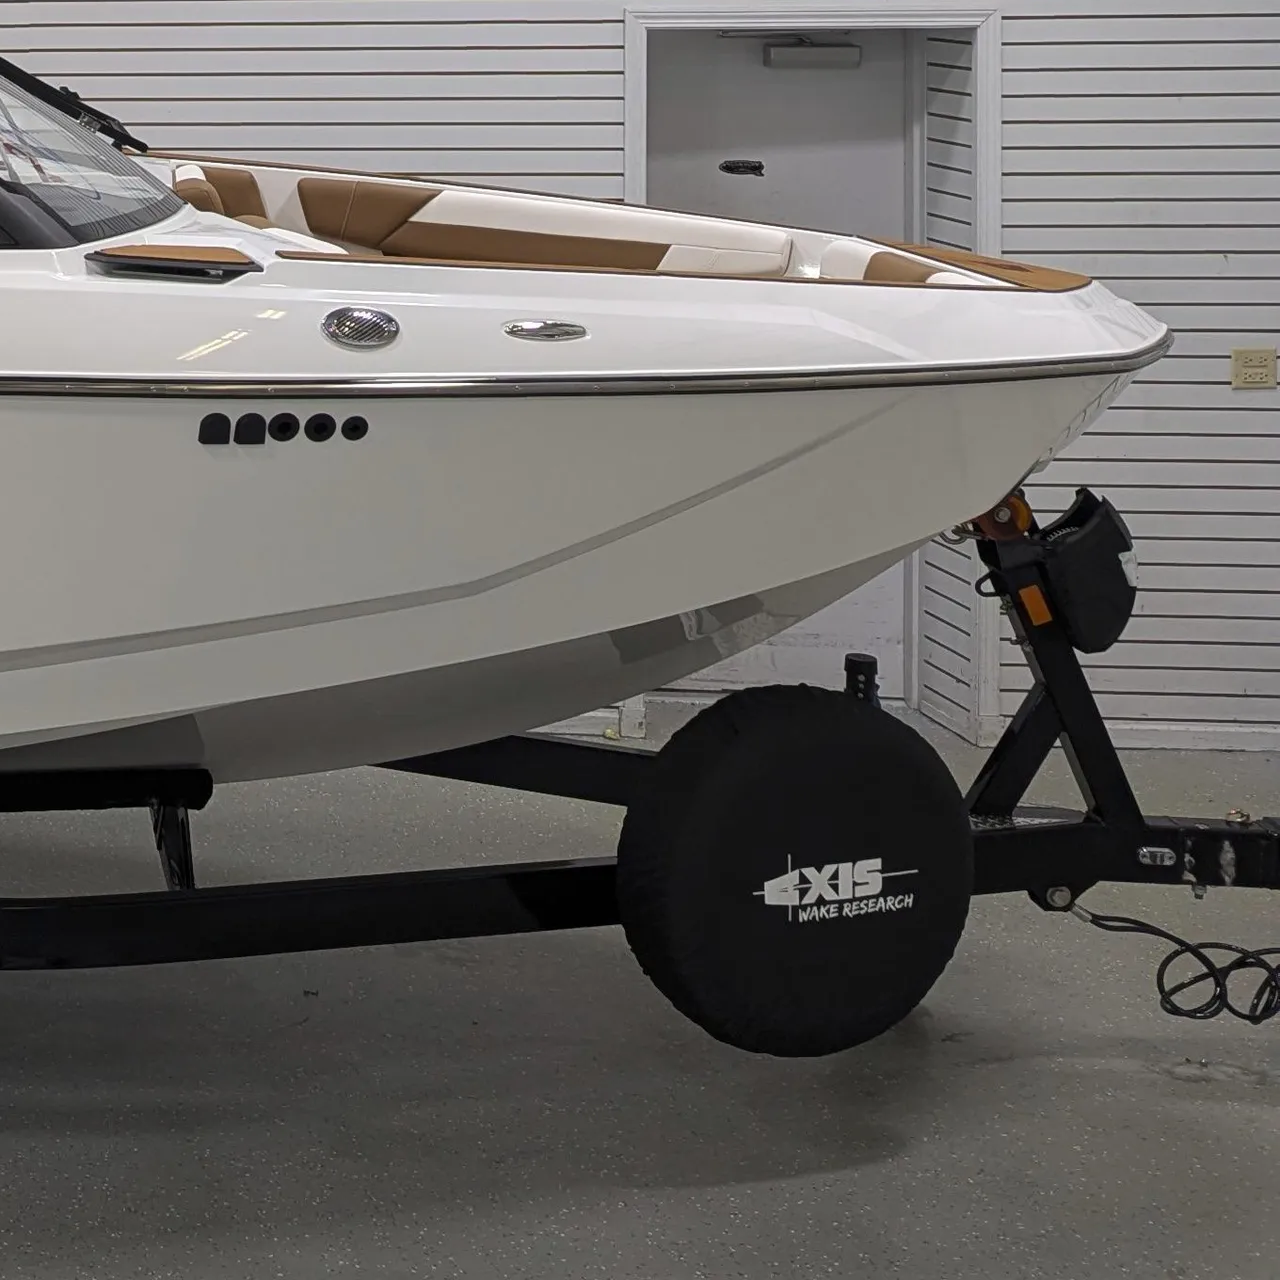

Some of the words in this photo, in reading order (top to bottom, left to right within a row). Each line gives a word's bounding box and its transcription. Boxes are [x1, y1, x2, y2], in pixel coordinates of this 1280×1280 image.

[763, 857, 883, 907] AXIS
[798, 903, 839, 923] WAKE
[842, 892, 915, 918] RESEARCH
